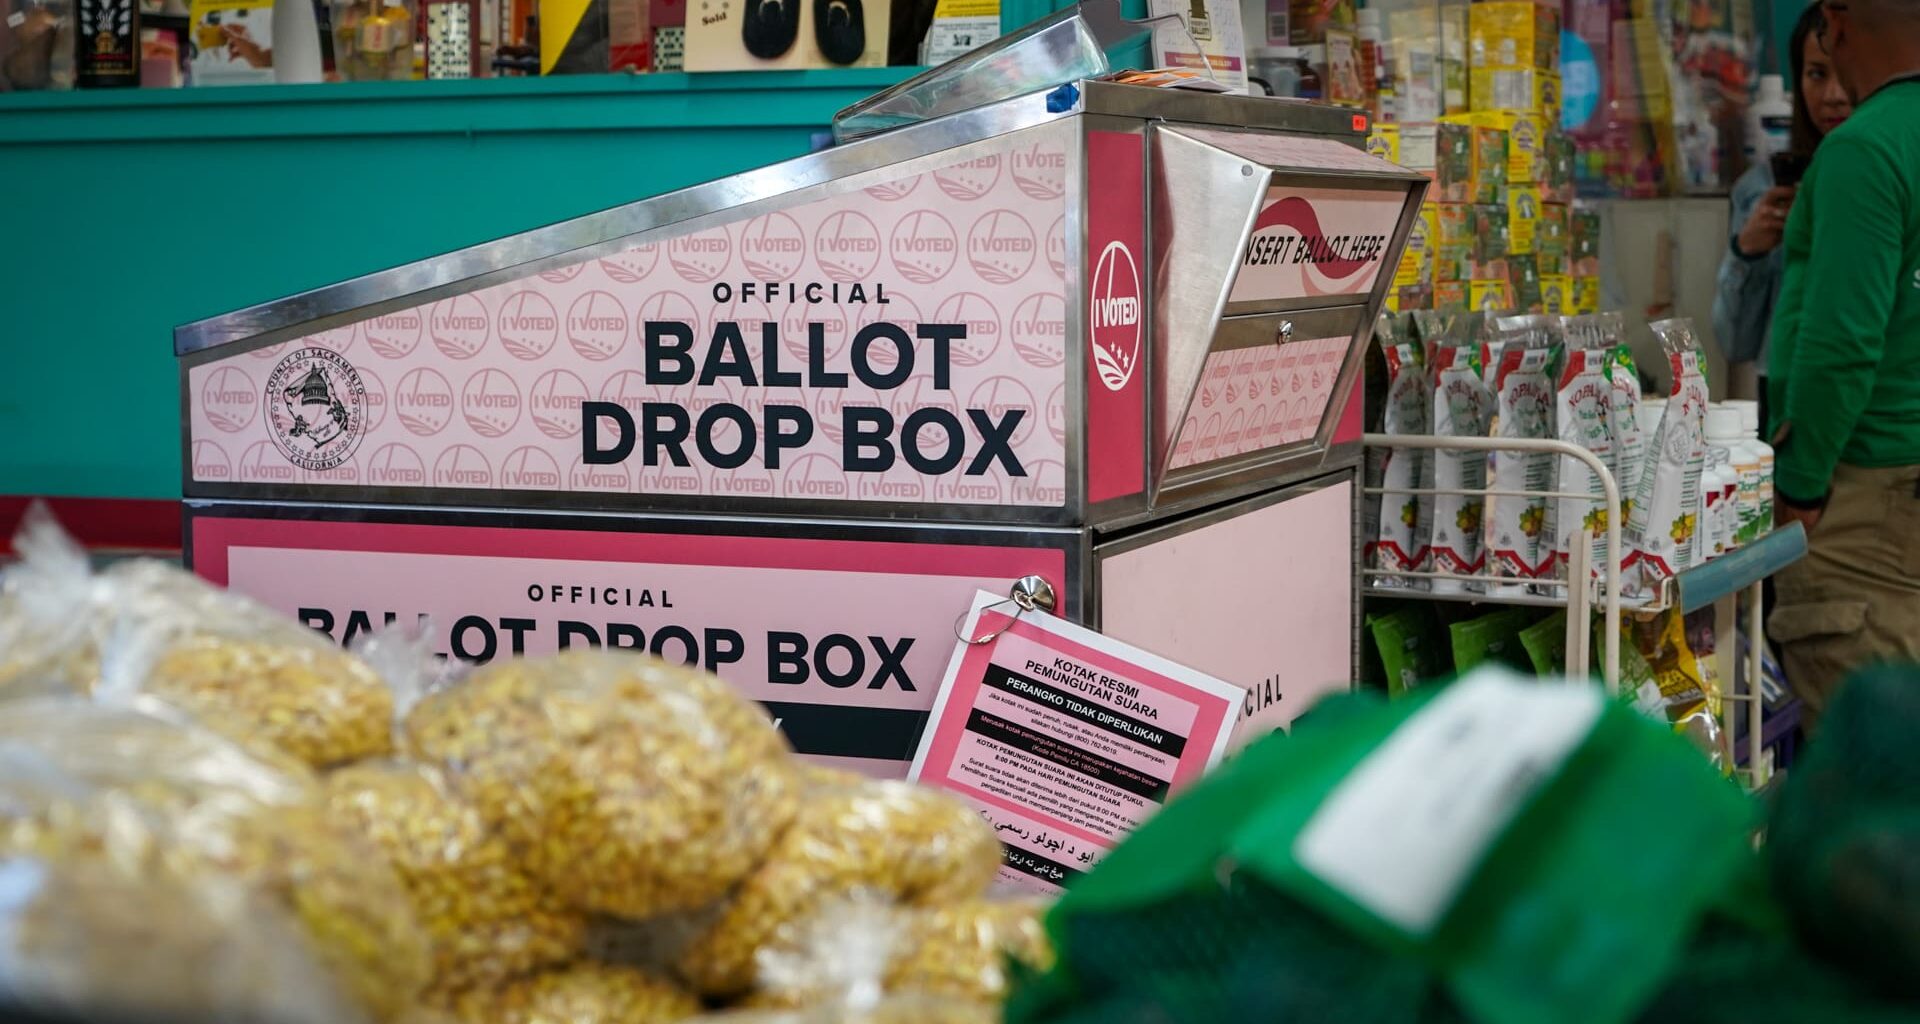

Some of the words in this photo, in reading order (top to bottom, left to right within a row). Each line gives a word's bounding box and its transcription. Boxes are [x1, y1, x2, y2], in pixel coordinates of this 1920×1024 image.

[951, 154, 997, 168] OTED
[1025, 153, 1064, 168] VOTE
[679, 238, 728, 252] VOTED
[753, 238, 800, 252] VOTED
[828, 238, 877, 252] VOTED
[904, 238, 953, 252] VOTED
[982, 238, 1032, 252] VOTED
[1244, 235, 1295, 266] NSERT
[1292, 235, 1350, 264] BALLOT
[1347, 235, 1386, 262] HERE
[712, 281, 891, 304] OFFICIAL
[1095, 299, 1099, 328] I
[1101, 296, 1138, 327] VOTED
[374, 317, 418, 330] VOTED
[442, 317, 486, 330] VOTED
[511, 317, 554, 331] VOTED
[579, 317, 624, 331] VOTED
[1025, 320, 1064, 335] VOTE
[644, 320, 966, 391] BALLOT
[266, 358, 291, 395] COUNTY
[295, 350, 306, 359] OF
[312, 349, 363, 395] SACRAMENTO
[213, 391, 254, 405] VOTED
[407, 394, 450, 407] VOTED
[474, 394, 517, 408] VOTED
[582, 401, 814, 470] DROP
[842, 406, 1028, 477] BOX
[290, 456, 342, 470] CALIFORNIA
[250, 464, 291, 479] VOTED
[380, 468, 422, 482] VOTED
[446, 470, 489, 484] VOTED
[514, 471, 557, 486] VOTED
[583, 473, 627, 488] VOTED
[653, 476, 698, 490] VOTED
[724, 477, 771, 492] VOTED
[797, 480, 844, 495] VOTED
[873, 483, 920, 497] VOTED
[950, 485, 997, 499] VOTED
[1028, 487, 1064, 501] VOTE
[527, 584, 674, 608] OFFICIAL
[298, 608, 536, 666] BAOT
[558, 620, 745, 677] DROP
[767, 630, 918, 692] BOX
[1053, 657, 1097, 682] KOTAK
[1098, 675, 1139, 698] RESMI
[1024, 659, 1112, 701] PEMUNGUTAN
[1113, 694, 1159, 719] SUARA
[1244, 673, 1282, 717] CIAL
[1005, 676, 1064, 706] PERANGKO
[1064, 699, 1096, 718] TIDAK
[1096, 711, 1163, 744] DIPERLUKAN
[976, 737, 998, 750] KOTAK
[998, 746, 1043, 767] PEMUNGUTAN
[1043, 763, 1065, 776] SUARA
[1066, 772, 1076, 780] INI
[1075, 775, 1094, 787] AKAN
[1094, 783, 1122, 798] DITUTUP
[1122, 794, 1145, 807] PUKUL
[1008, 759, 1019, 768] PM
[1019, 763, 1036, 774] PADA
[1037, 770, 1053, 781] HARI
[1053, 777, 1098, 798] PEMUNGUTAN
[1098, 794, 1121, 807] SUARA
